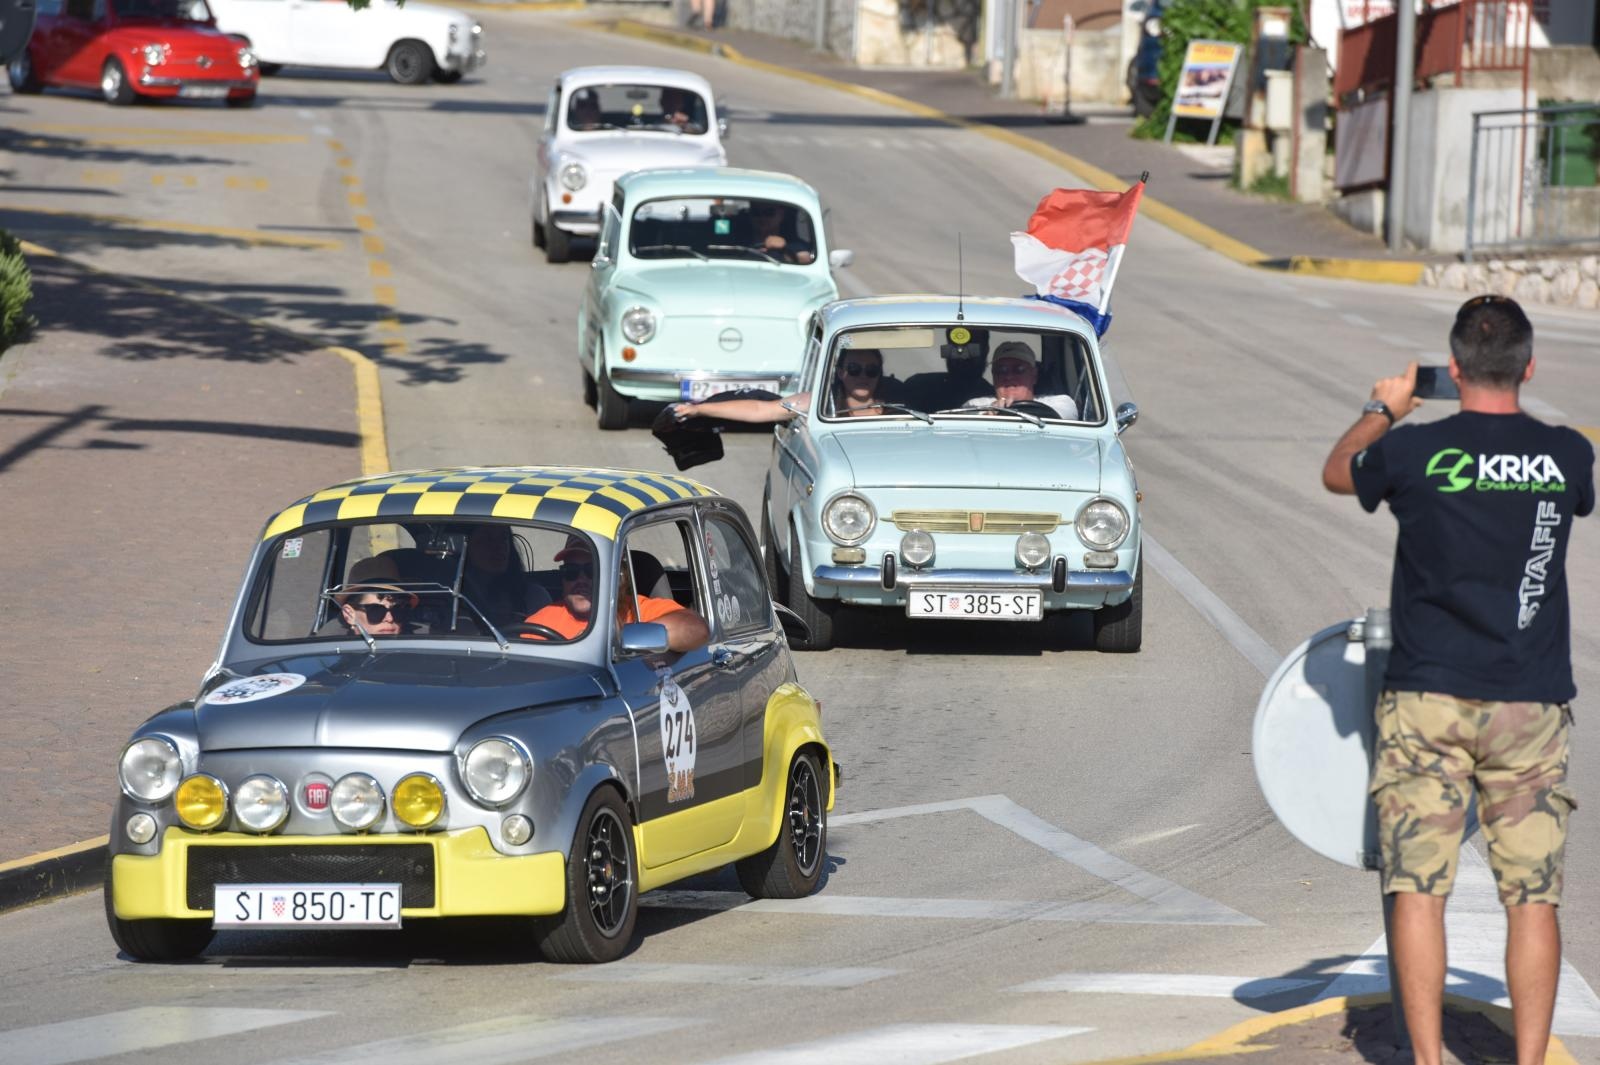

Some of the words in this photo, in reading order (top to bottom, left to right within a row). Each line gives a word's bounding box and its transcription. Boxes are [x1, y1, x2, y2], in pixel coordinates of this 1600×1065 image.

[1479, 454, 1566, 482] KRKA
[1518, 501, 1562, 629] STAFF
[923, 594, 947, 613] ST
[964, 594, 1037, 615] 385-SF
[665, 709, 693, 759] 274
[308, 788, 327, 804] FIAT
[236, 891, 262, 921] ŠI
[292, 891, 394, 921] 850-TC
